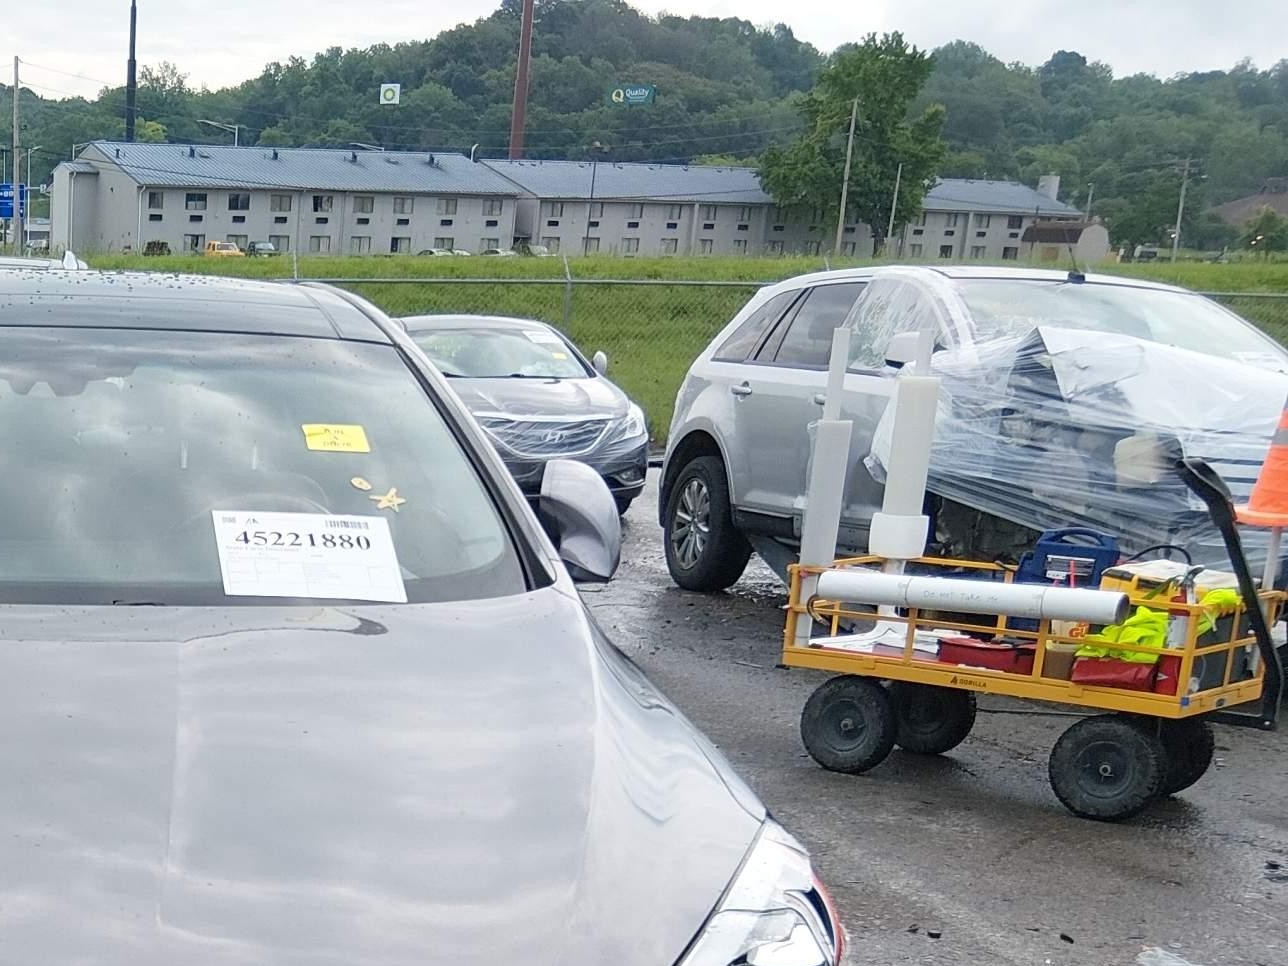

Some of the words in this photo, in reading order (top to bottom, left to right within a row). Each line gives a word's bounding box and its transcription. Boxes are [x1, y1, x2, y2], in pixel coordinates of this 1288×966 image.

[626, 88, 649, 97] Quality
[235, 530, 371, 551] 45221880
[959, 678, 987, 688] GORILLA
